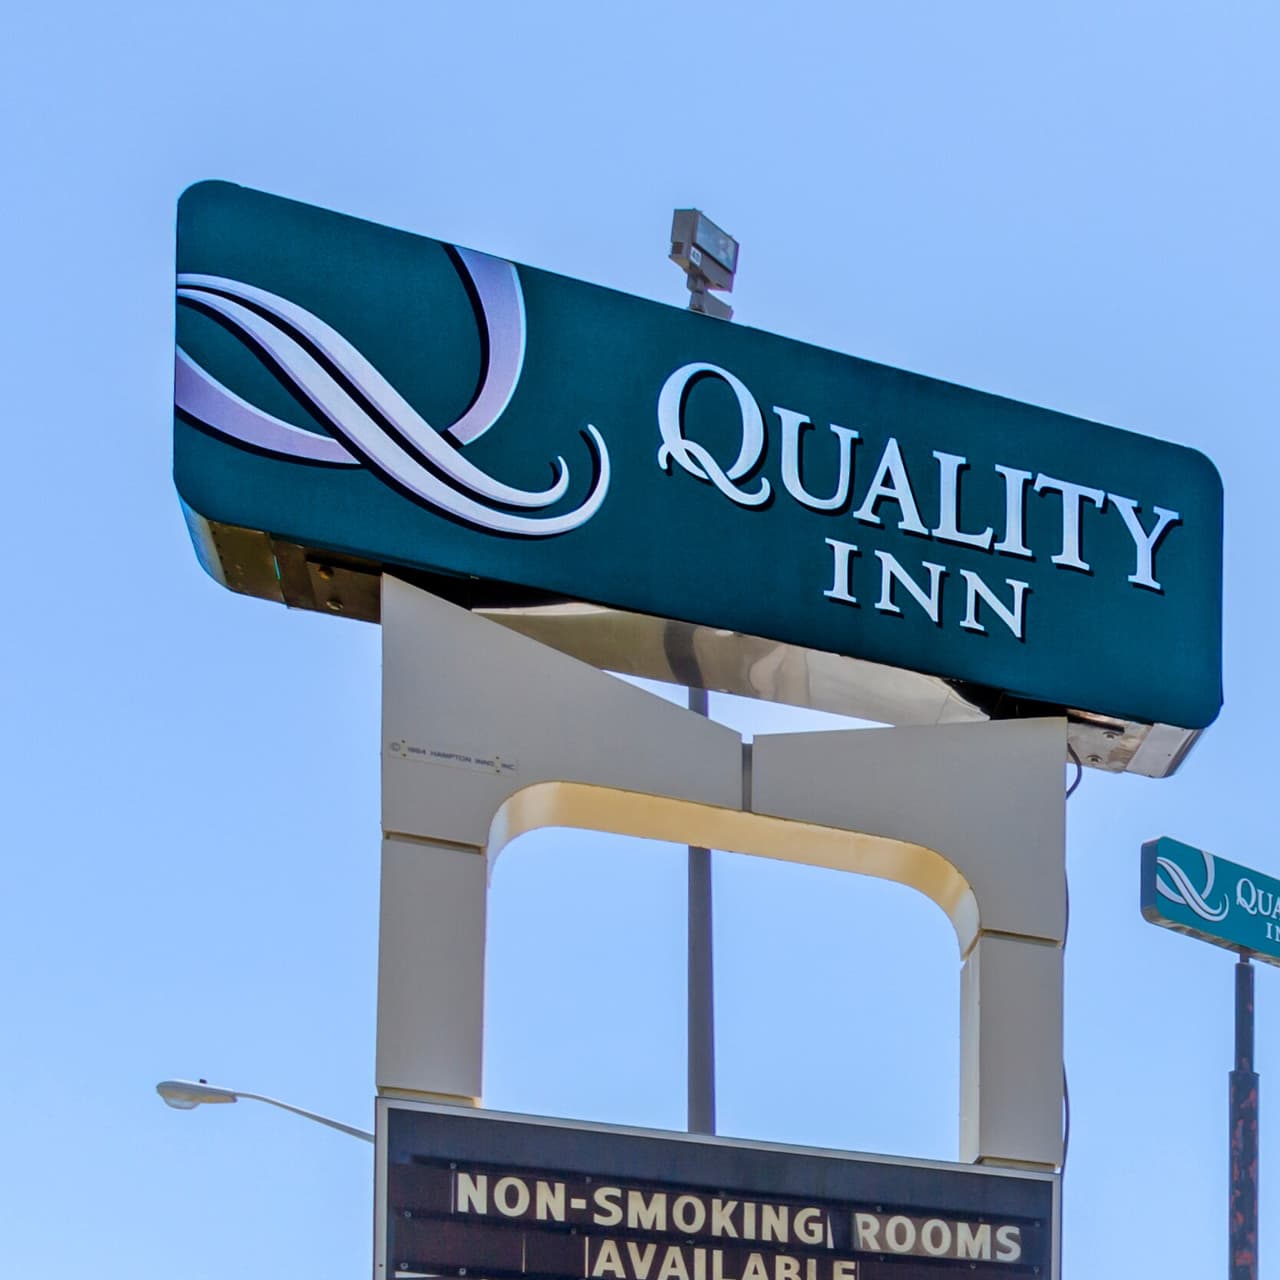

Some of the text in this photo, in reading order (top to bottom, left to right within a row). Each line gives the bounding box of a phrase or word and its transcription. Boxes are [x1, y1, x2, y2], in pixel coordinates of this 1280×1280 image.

[657, 362, 1180, 591] QUALITY
[823, 537, 1030, 639] INN
[430, 750, 472, 763] HAMPTON
[457, 1172, 1022, 1262] NON-SMOKING ROOMS
